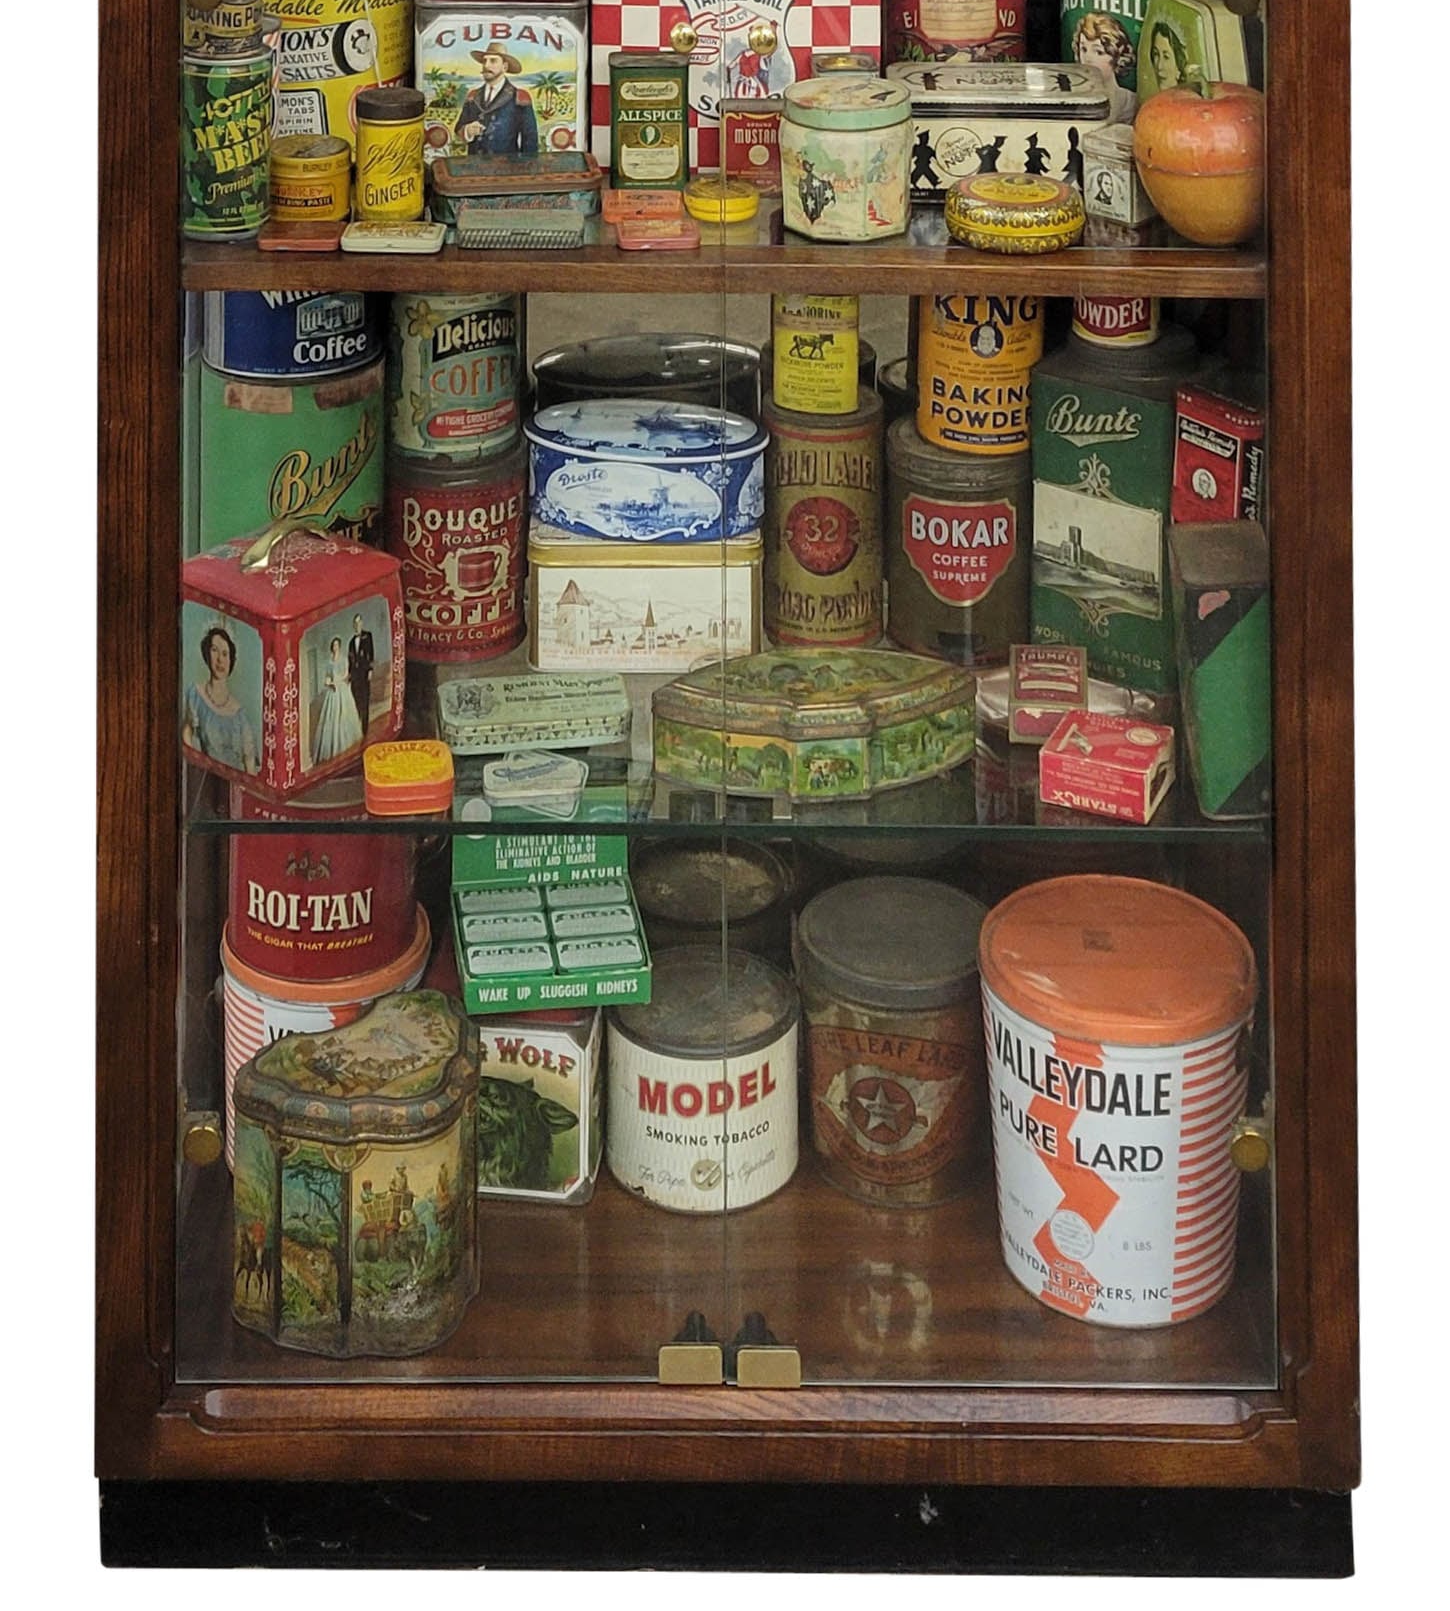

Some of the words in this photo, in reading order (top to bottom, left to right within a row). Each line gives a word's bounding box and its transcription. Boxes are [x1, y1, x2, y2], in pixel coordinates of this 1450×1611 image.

[435, 23, 563, 53] CUBAN
[282, 64, 337, 81] SALTS
[287, 106, 315, 115] TABS
[618, 109, 682, 122] ALLSPICE
[365, 177, 415, 207] GINGER
[933, 294, 1040, 326] KING
[437, 310, 516, 352] Delicious
[293, 332, 366, 365] Coffee
[1046, 394, 1142, 436] Bunte
[558, 470, 604, 487] Droste
[442, 528, 508, 545] ROASTED
[803, 514, 839, 542] 32
[911, 511, 1009, 548] BOKAR
[932, 553, 988, 568] COFFEE
[932, 570, 987, 585] SUPREME
[419, 628, 453, 644] TRACY
[456, 629, 465, 643] &
[528, 871, 559, 883] AIDS
[571, 866, 623, 880] NATURE
[248, 880, 373, 932] ROI-TAN
[264, 933, 293, 949] CIGAR
[298, 940, 323, 950] THAT
[479, 988, 508, 1001] WAKE
[517, 987, 531, 999] UP
[540, 984, 588, 998] SLUGGISH
[596, 980, 637, 995] KIDNEYS
[495, 1037, 576, 1078] WOLF
[855, 1035, 907, 1058] LEAF
[992, 1013, 1172, 1118] VALLEYDALE
[638, 1061, 776, 1119] MODEL
[646, 1125, 707, 1147] SMOKING
[713, 1121, 770, 1145] TOBACCO
[999, 1097, 1057, 1155] PURE
[1074, 1136, 1164, 1173] LARD
[1004, 1226, 1063, 1285] VALLEYDALE
[1068, 1278, 1136, 1303] PACKERS,
